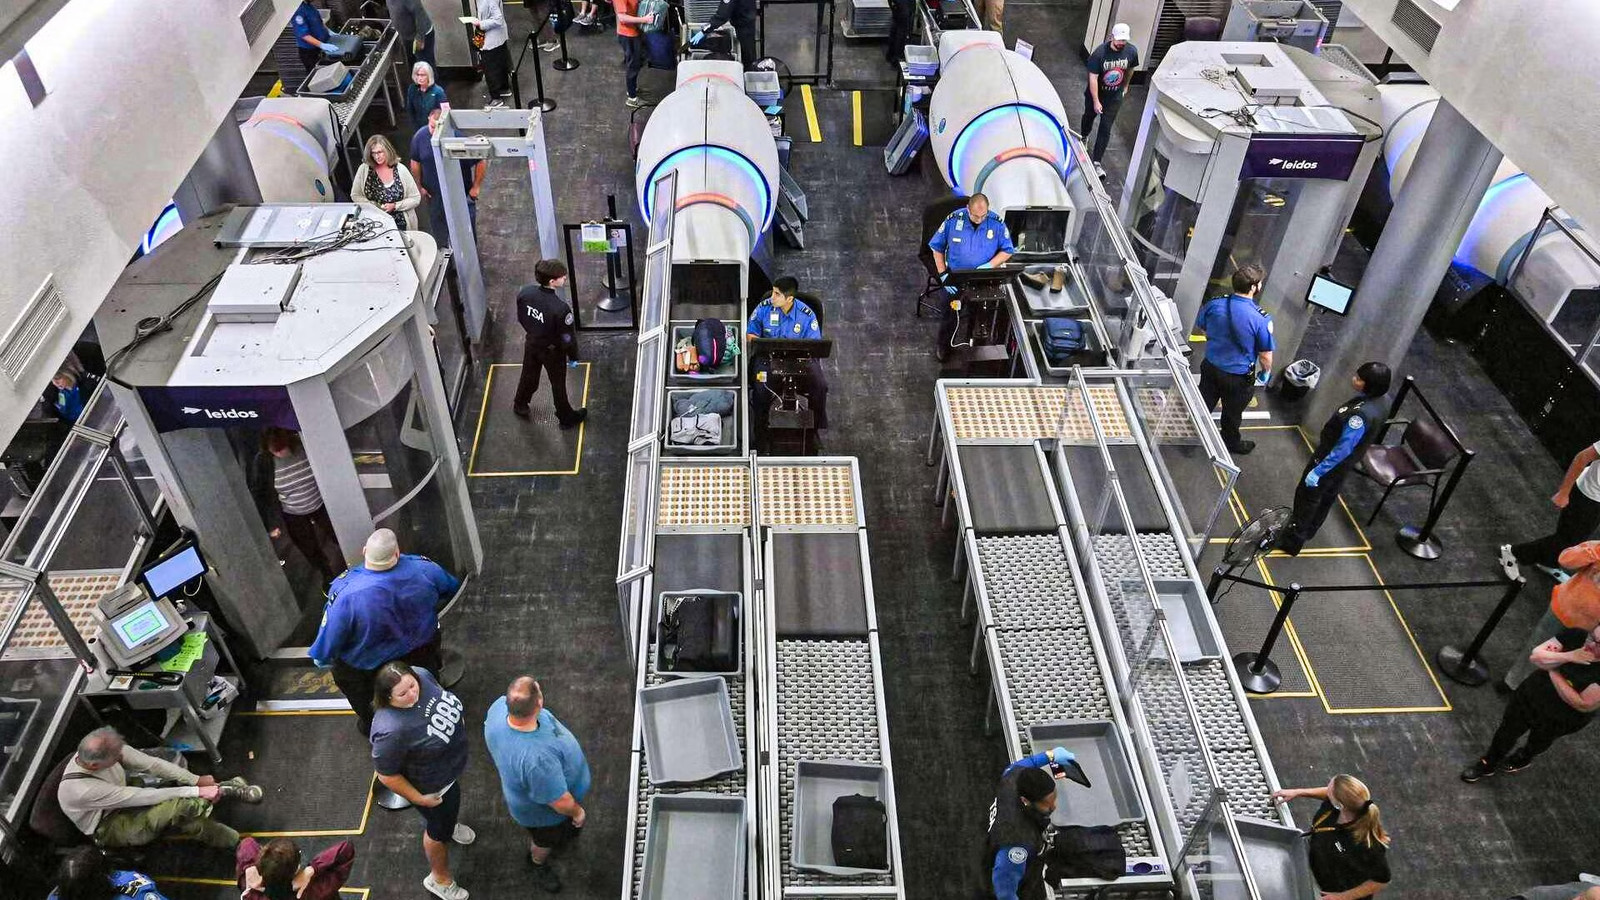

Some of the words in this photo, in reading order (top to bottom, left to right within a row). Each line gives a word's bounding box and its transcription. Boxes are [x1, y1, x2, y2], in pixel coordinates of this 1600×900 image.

[1281, 160, 1318, 170] leidos
[526, 305, 544, 324] TSA
[204, 408, 259, 419] leidos
[426, 690, 464, 744] 1985
[987, 796, 998, 833] TSA
